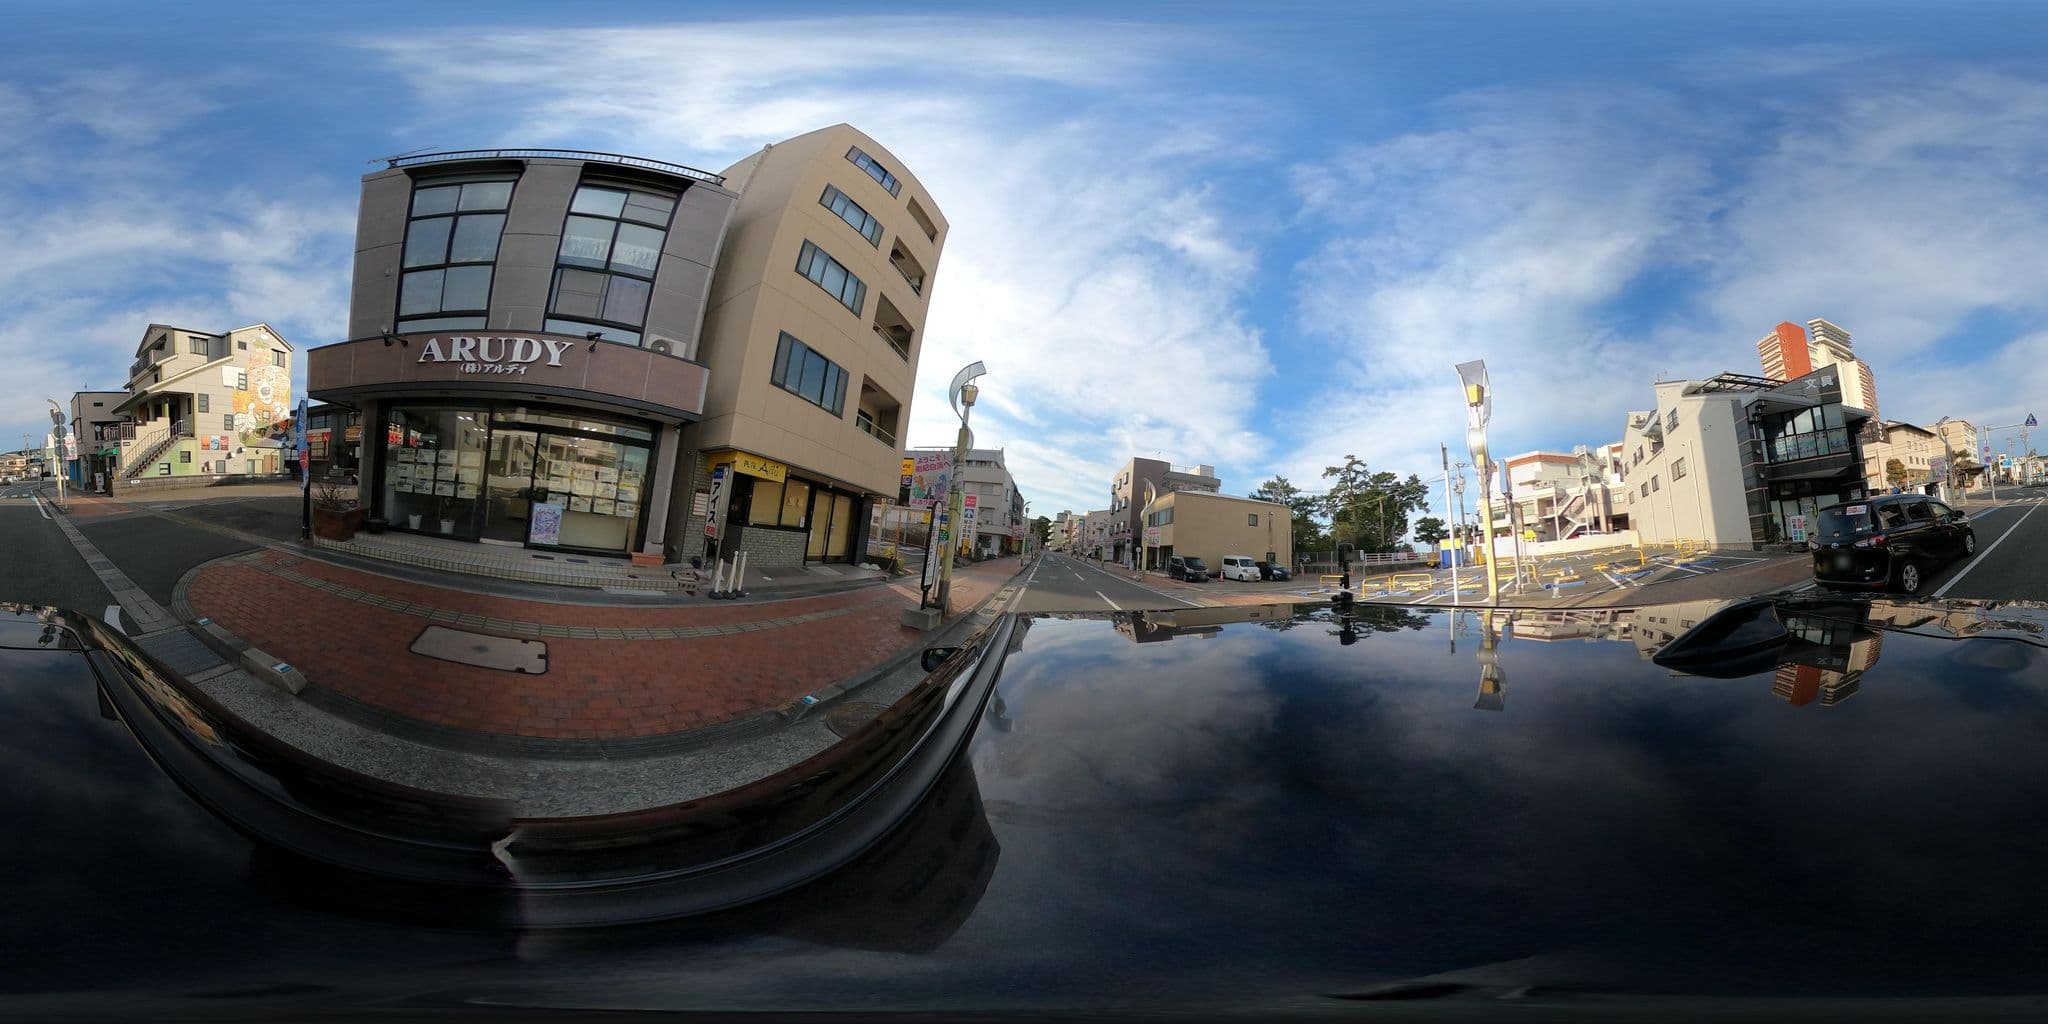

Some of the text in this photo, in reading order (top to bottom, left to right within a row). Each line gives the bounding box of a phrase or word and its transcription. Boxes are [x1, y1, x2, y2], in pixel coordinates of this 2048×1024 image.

[418, 336, 574, 367] ARUDY
[1805, 375, 1834, 389] 文具
[708, 482, 721, 524] アイス
